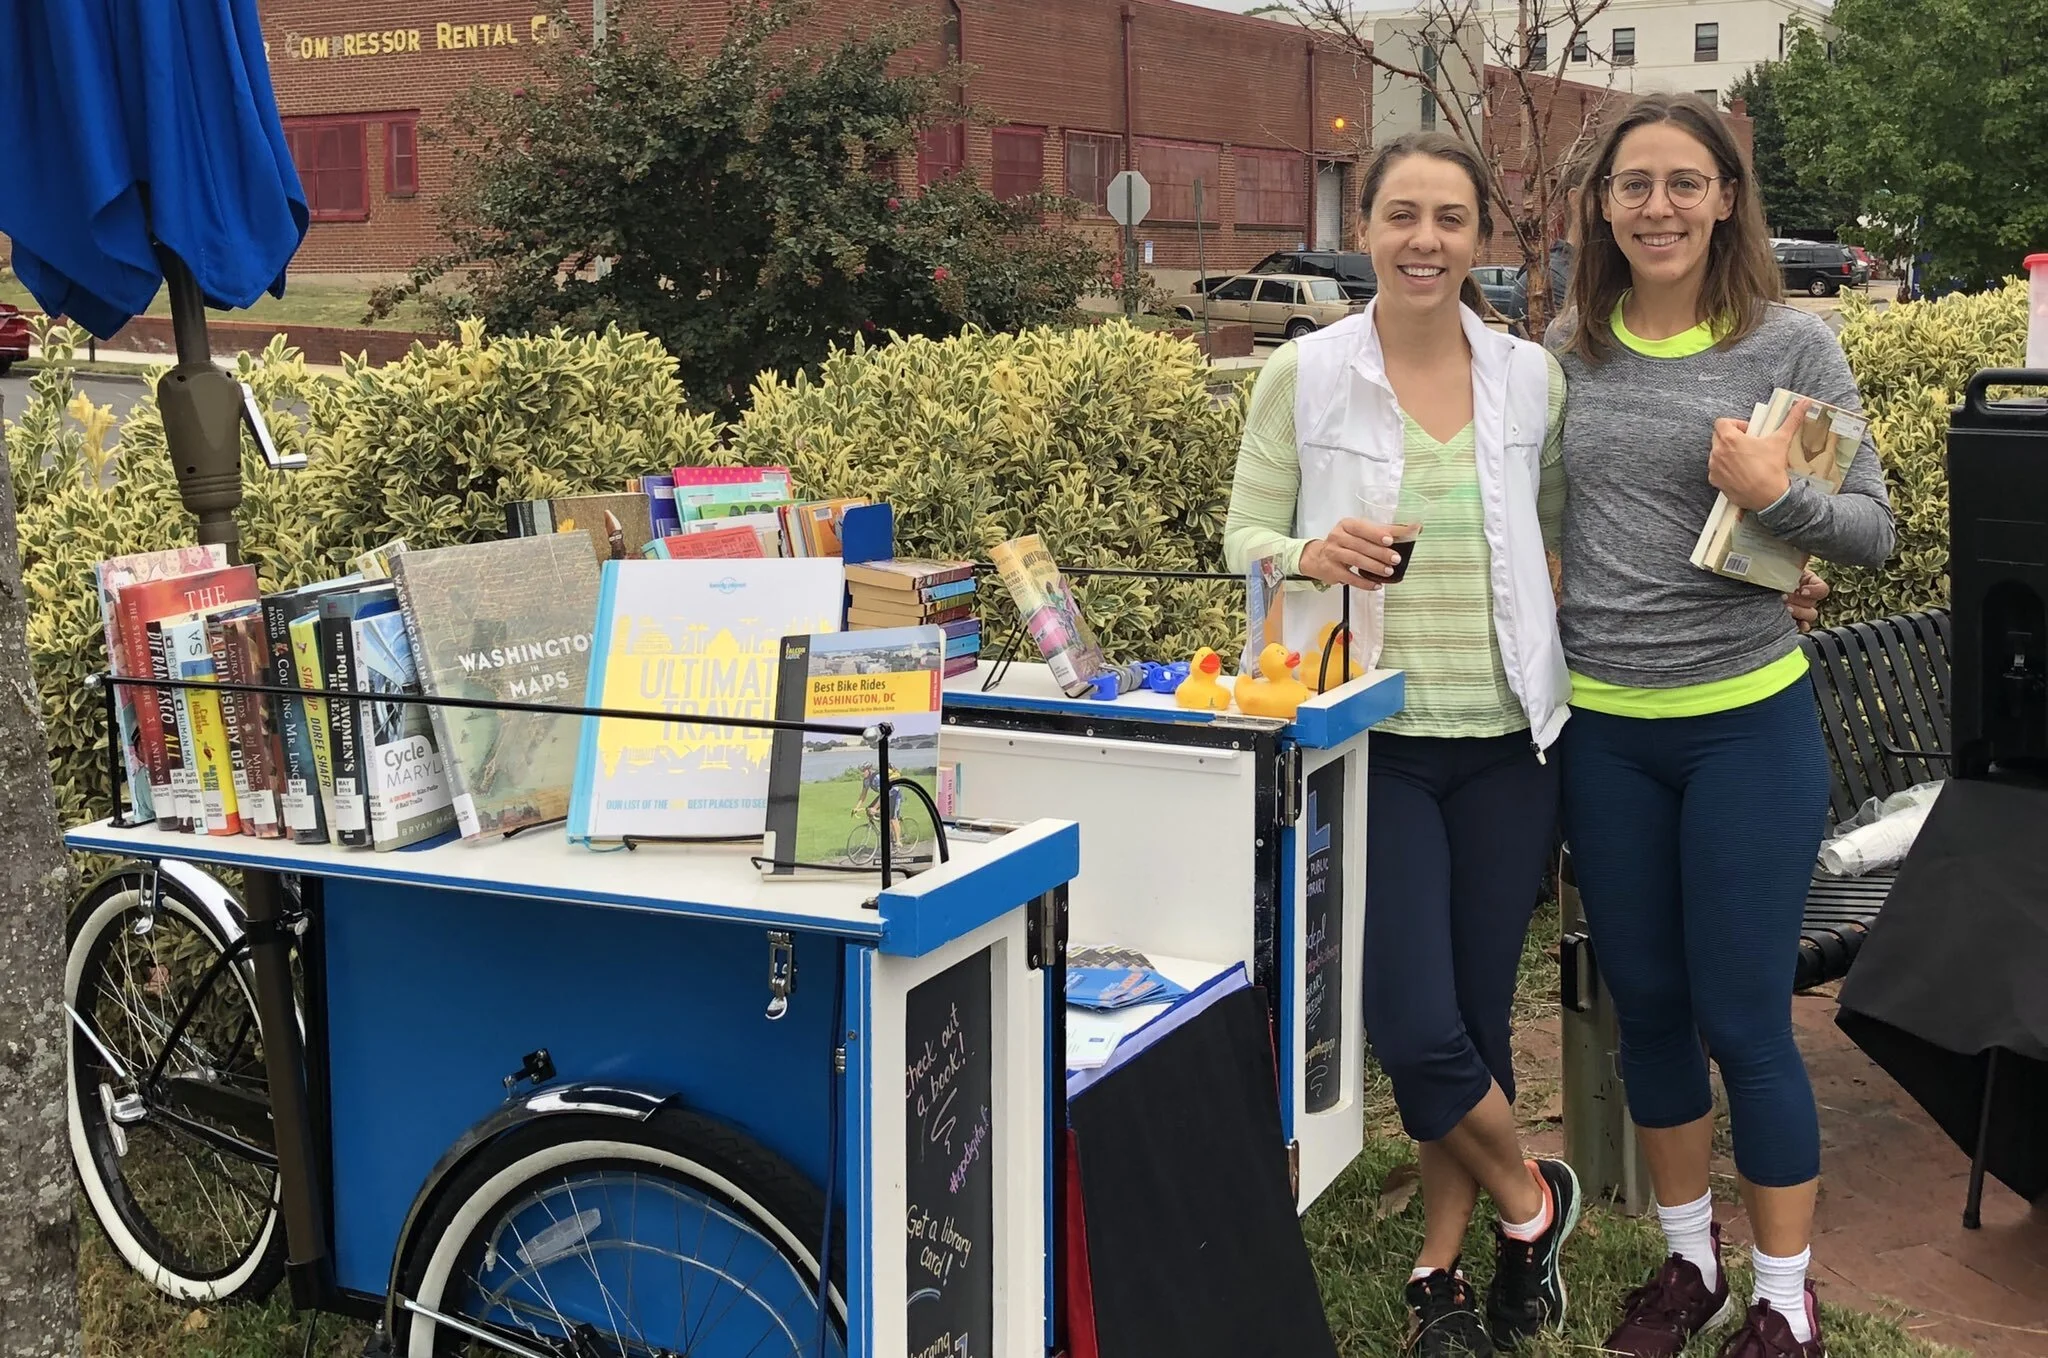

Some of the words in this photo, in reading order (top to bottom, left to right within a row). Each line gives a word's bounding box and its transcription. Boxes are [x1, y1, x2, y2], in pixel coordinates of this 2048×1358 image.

[436, 22, 519, 49] RENTAL
[128, 601, 139, 621] THE
[184, 585, 229, 612] THE
[267, 606, 279, 639] BAYARD
[276, 608, 287, 636] LOUIS
[393, 573, 423, 663] WASHINGTON
[132, 623, 145, 660] STARS
[335, 631, 345, 652] THE
[457, 632, 594, 673] WASHINGTO
[228, 643, 239, 676] LAURA
[419, 666, 429, 680] IN
[529, 664, 541, 673] IN
[508, 670, 570, 698] MAPS
[640, 657, 779, 700] ULTIMAT
[813, 681, 835, 693] Best
[836, 679, 858, 692] Bike
[860, 678, 886, 691] Rides
[146, 631, 175, 724] DIFRANESCO
[164, 734, 181, 760] ALL
[301, 665, 319, 712] STARUP
[310, 717, 326, 751] DOREE
[423, 684, 440, 721] MPS
[813, 693, 880, 706] WASHINGTON,
[883, 692, 896, 703] DC
[177, 713, 189, 747] HUMAN
[285, 723, 298, 747] MR.
[150, 741, 162, 772] ANITA
[231, 750, 244, 771] OF
[252, 753, 263, 784] MING
[384, 742, 425, 771] Cycle
[246, 758, 257, 791] MURD
[623, 799, 640, 810] LIST
[653, 799, 669, 810] THE
[687, 799, 707, 810] BEST
[709, 798, 740, 809] PLACES
[740, 798, 751, 809] TO
[752, 798, 768, 809] SEE
[401, 821, 433, 837] BRYAN
[1310, 857, 1330, 877] PUBLIC
[942, 1002, 960, 1048] out
[917, 1094, 929, 1118] a
[930, 1031, 966, 1103] book!
[906, 1204, 930, 1239] Get
[929, 1220, 937, 1242] a
[940, 1215, 972, 1269] library
[920, 1246, 954, 1287] card!
